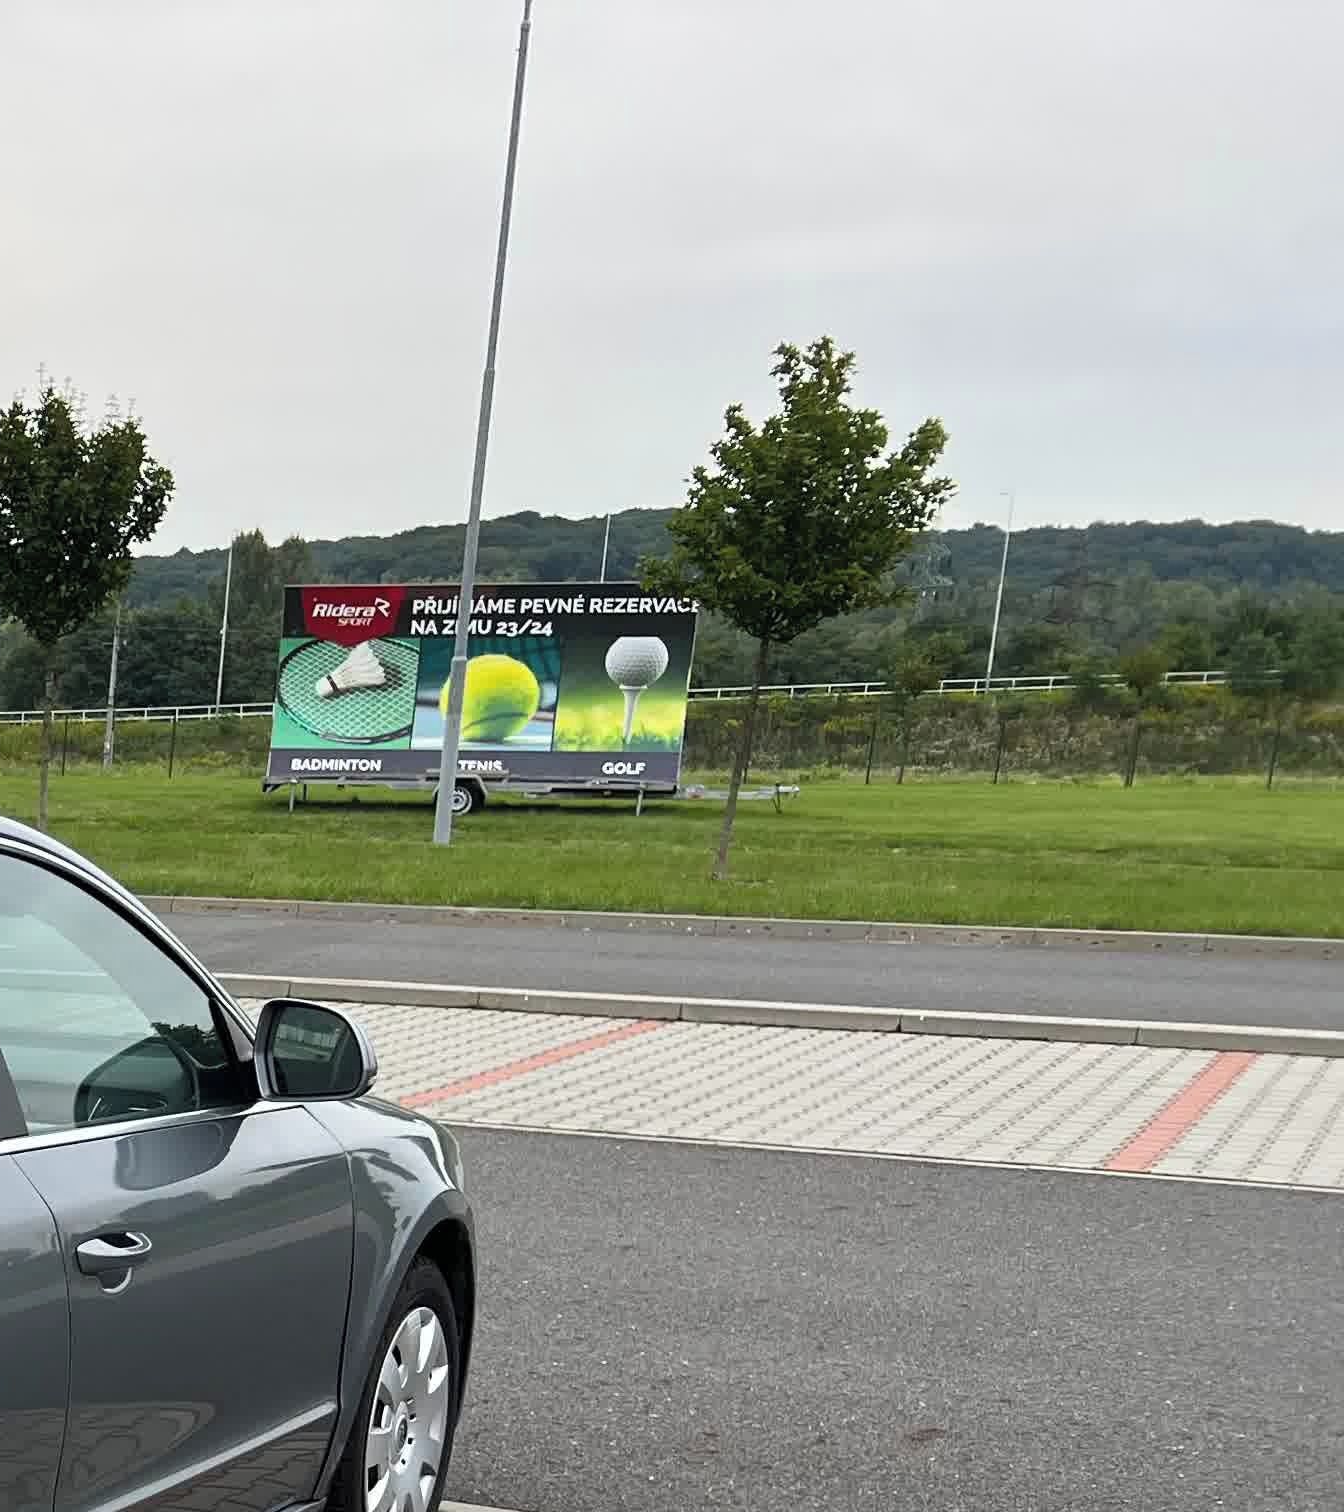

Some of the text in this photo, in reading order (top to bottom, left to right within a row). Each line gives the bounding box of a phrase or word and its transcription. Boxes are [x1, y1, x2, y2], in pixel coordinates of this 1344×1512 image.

[412, 595, 516, 615] PŘIJÍÁME
[520, 594, 585, 614] PEVNÉ
[337, 617, 373, 626] SPORT
[410, 619, 438, 635] NA
[495, 619, 553, 637] 23/24
[291, 758, 382, 772] BADMINTON
[458, 759, 503, 771] TENIS
[602, 761, 646, 775] GOLF
